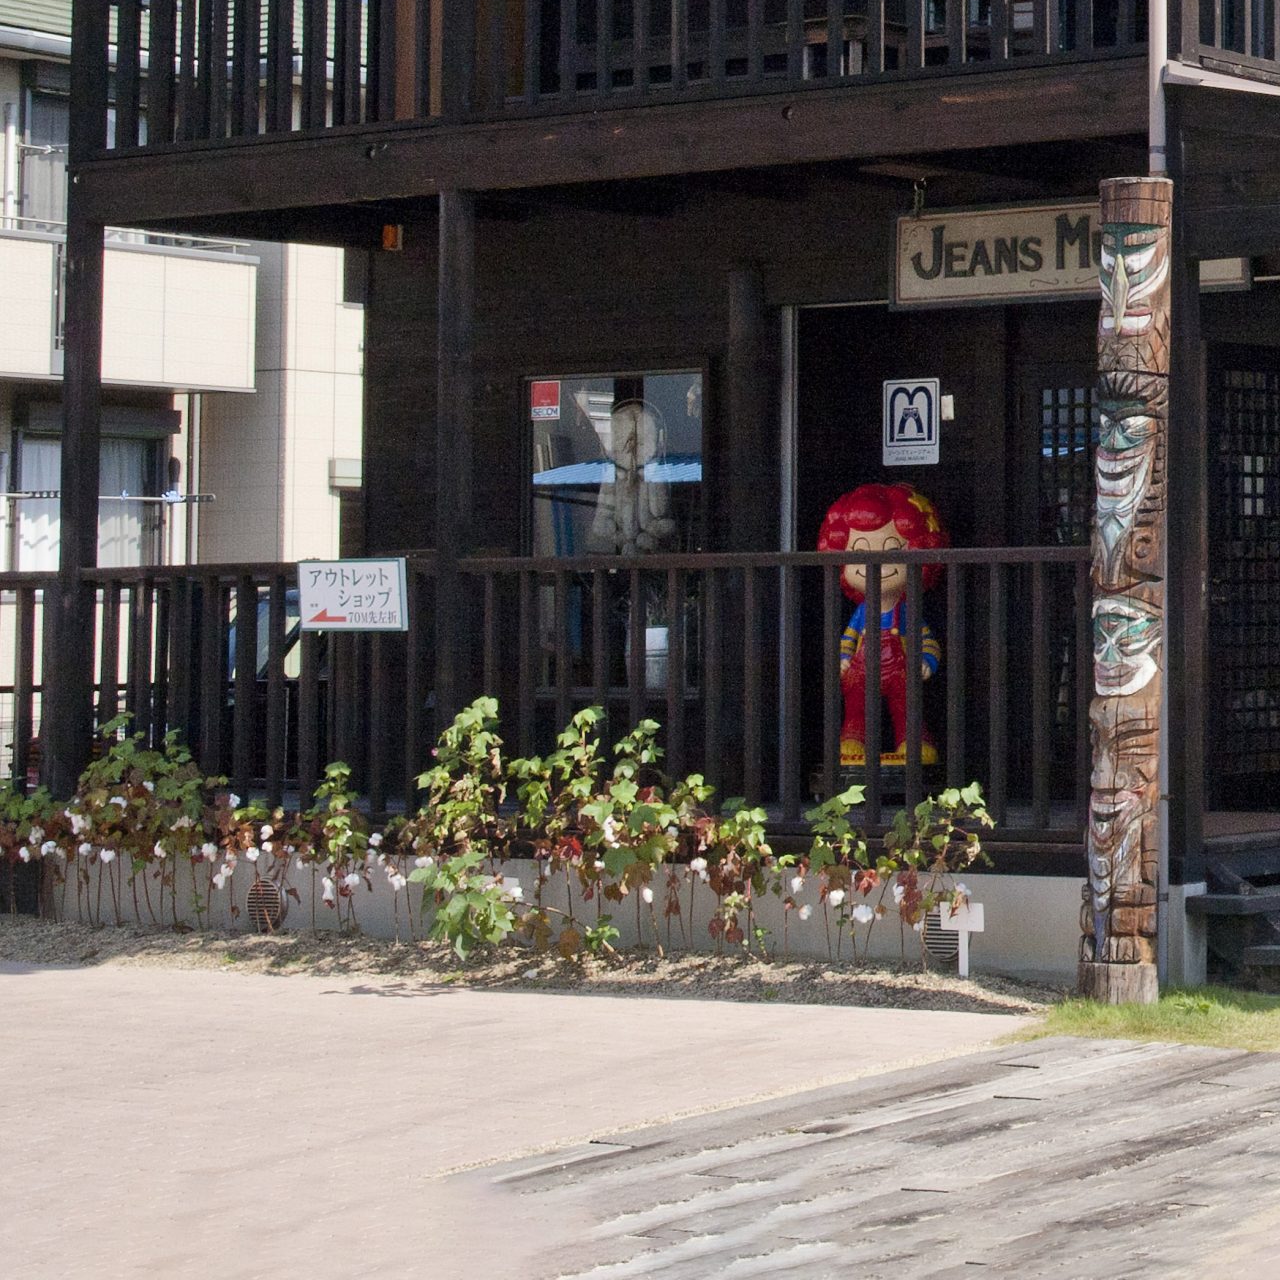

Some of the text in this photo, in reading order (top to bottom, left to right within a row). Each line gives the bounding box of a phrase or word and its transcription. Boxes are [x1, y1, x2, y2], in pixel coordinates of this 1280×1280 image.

[910, 224, 1044, 280] JEANS
[309, 568, 389, 588] アウトレット
[338, 587, 393, 608] ショップ
